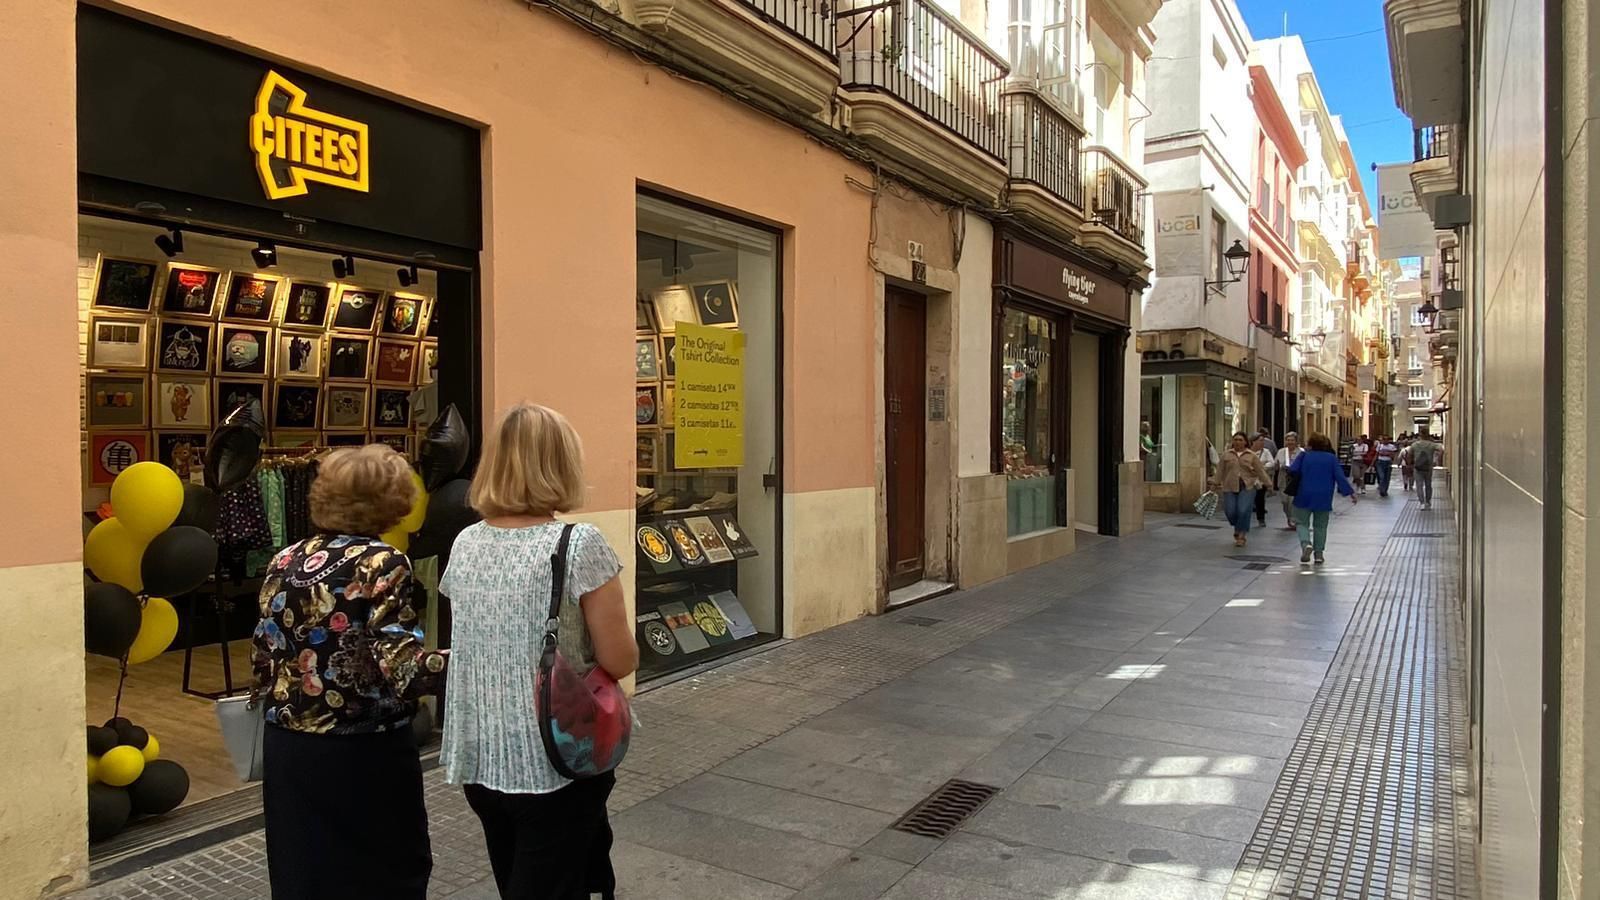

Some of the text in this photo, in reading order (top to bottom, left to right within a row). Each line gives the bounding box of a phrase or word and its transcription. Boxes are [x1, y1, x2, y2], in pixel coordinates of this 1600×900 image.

[250, 112, 358, 175] CITEES
[909, 242, 922, 261] 24
[1062, 267, 1096, 296] flying tiger
[681, 335, 726, 352] The Original
[681, 348, 740, 367] Tshirt Collection
[681, 380, 686, 391] 1
[687, 382, 716, 393] camiseta
[680, 398, 686, 409] 2
[687, 400, 720, 410] camisetas
[680, 416, 686, 428] 3
[687, 418, 720, 429] camisetas
